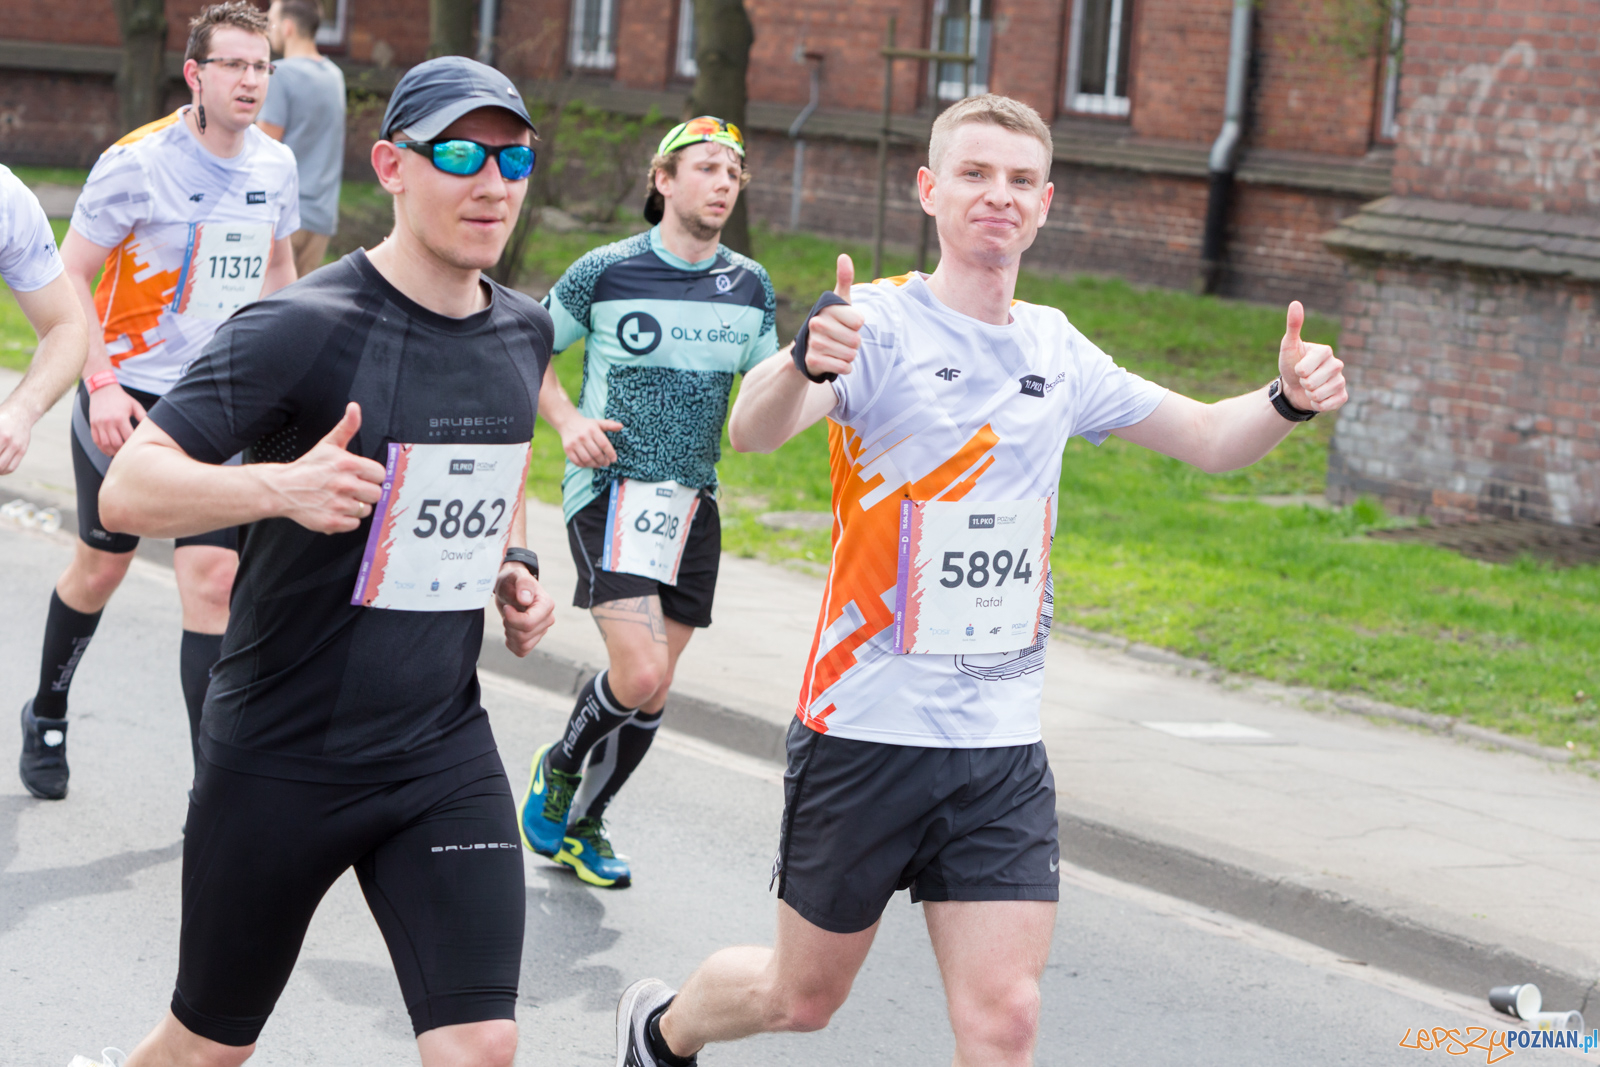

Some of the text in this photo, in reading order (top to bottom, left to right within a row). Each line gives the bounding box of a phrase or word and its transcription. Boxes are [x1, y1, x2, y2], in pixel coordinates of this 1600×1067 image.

[209, 255, 263, 279] 11312
[671, 327, 749, 346] OLX GROUP
[935, 367, 961, 381] 4F
[428, 416, 508, 427] BRUBECK
[413, 498, 506, 539] 5862
[972, 517, 994, 525] 11.PKO
[441, 549, 473, 561] Dawid
[939, 548, 1033, 589] 5894
[975, 596, 1003, 608] Rafał
[989, 626, 1002, 635] 4F
[562, 694, 600, 759] Kalenji
[431, 843, 517, 852] BRUBECK
